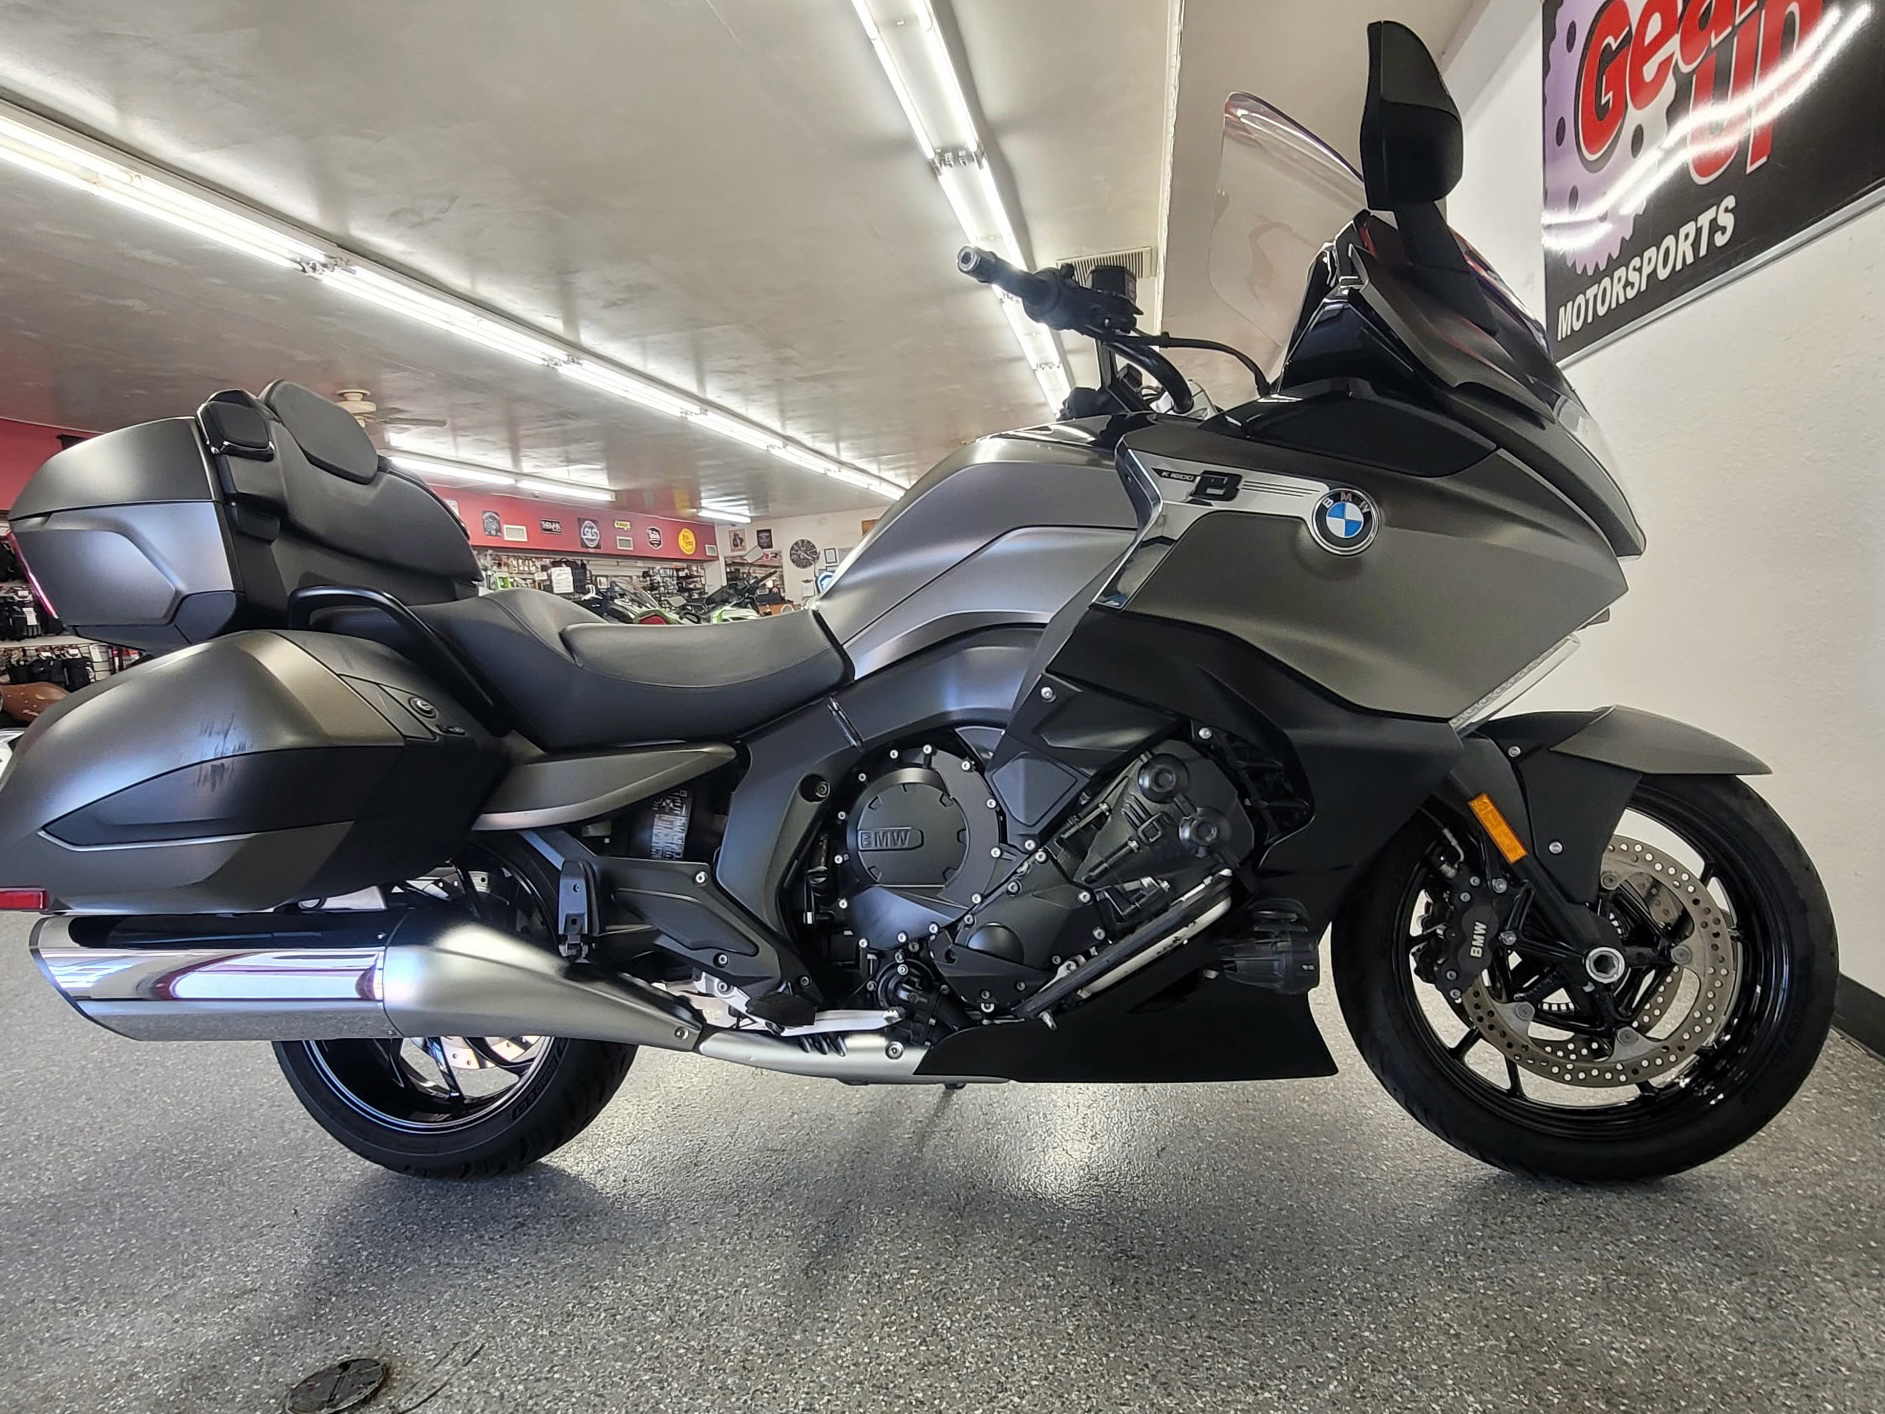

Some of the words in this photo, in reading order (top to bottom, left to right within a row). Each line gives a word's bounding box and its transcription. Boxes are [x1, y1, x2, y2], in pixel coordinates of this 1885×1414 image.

[1557, 194, 1737, 342] MOTORSPORTS
[1170, 472, 1195, 481] 1600
[1322, 491, 1371, 513] BMW
[861, 831, 910, 848] BMW
[1470, 921, 1487, 958] BMW
